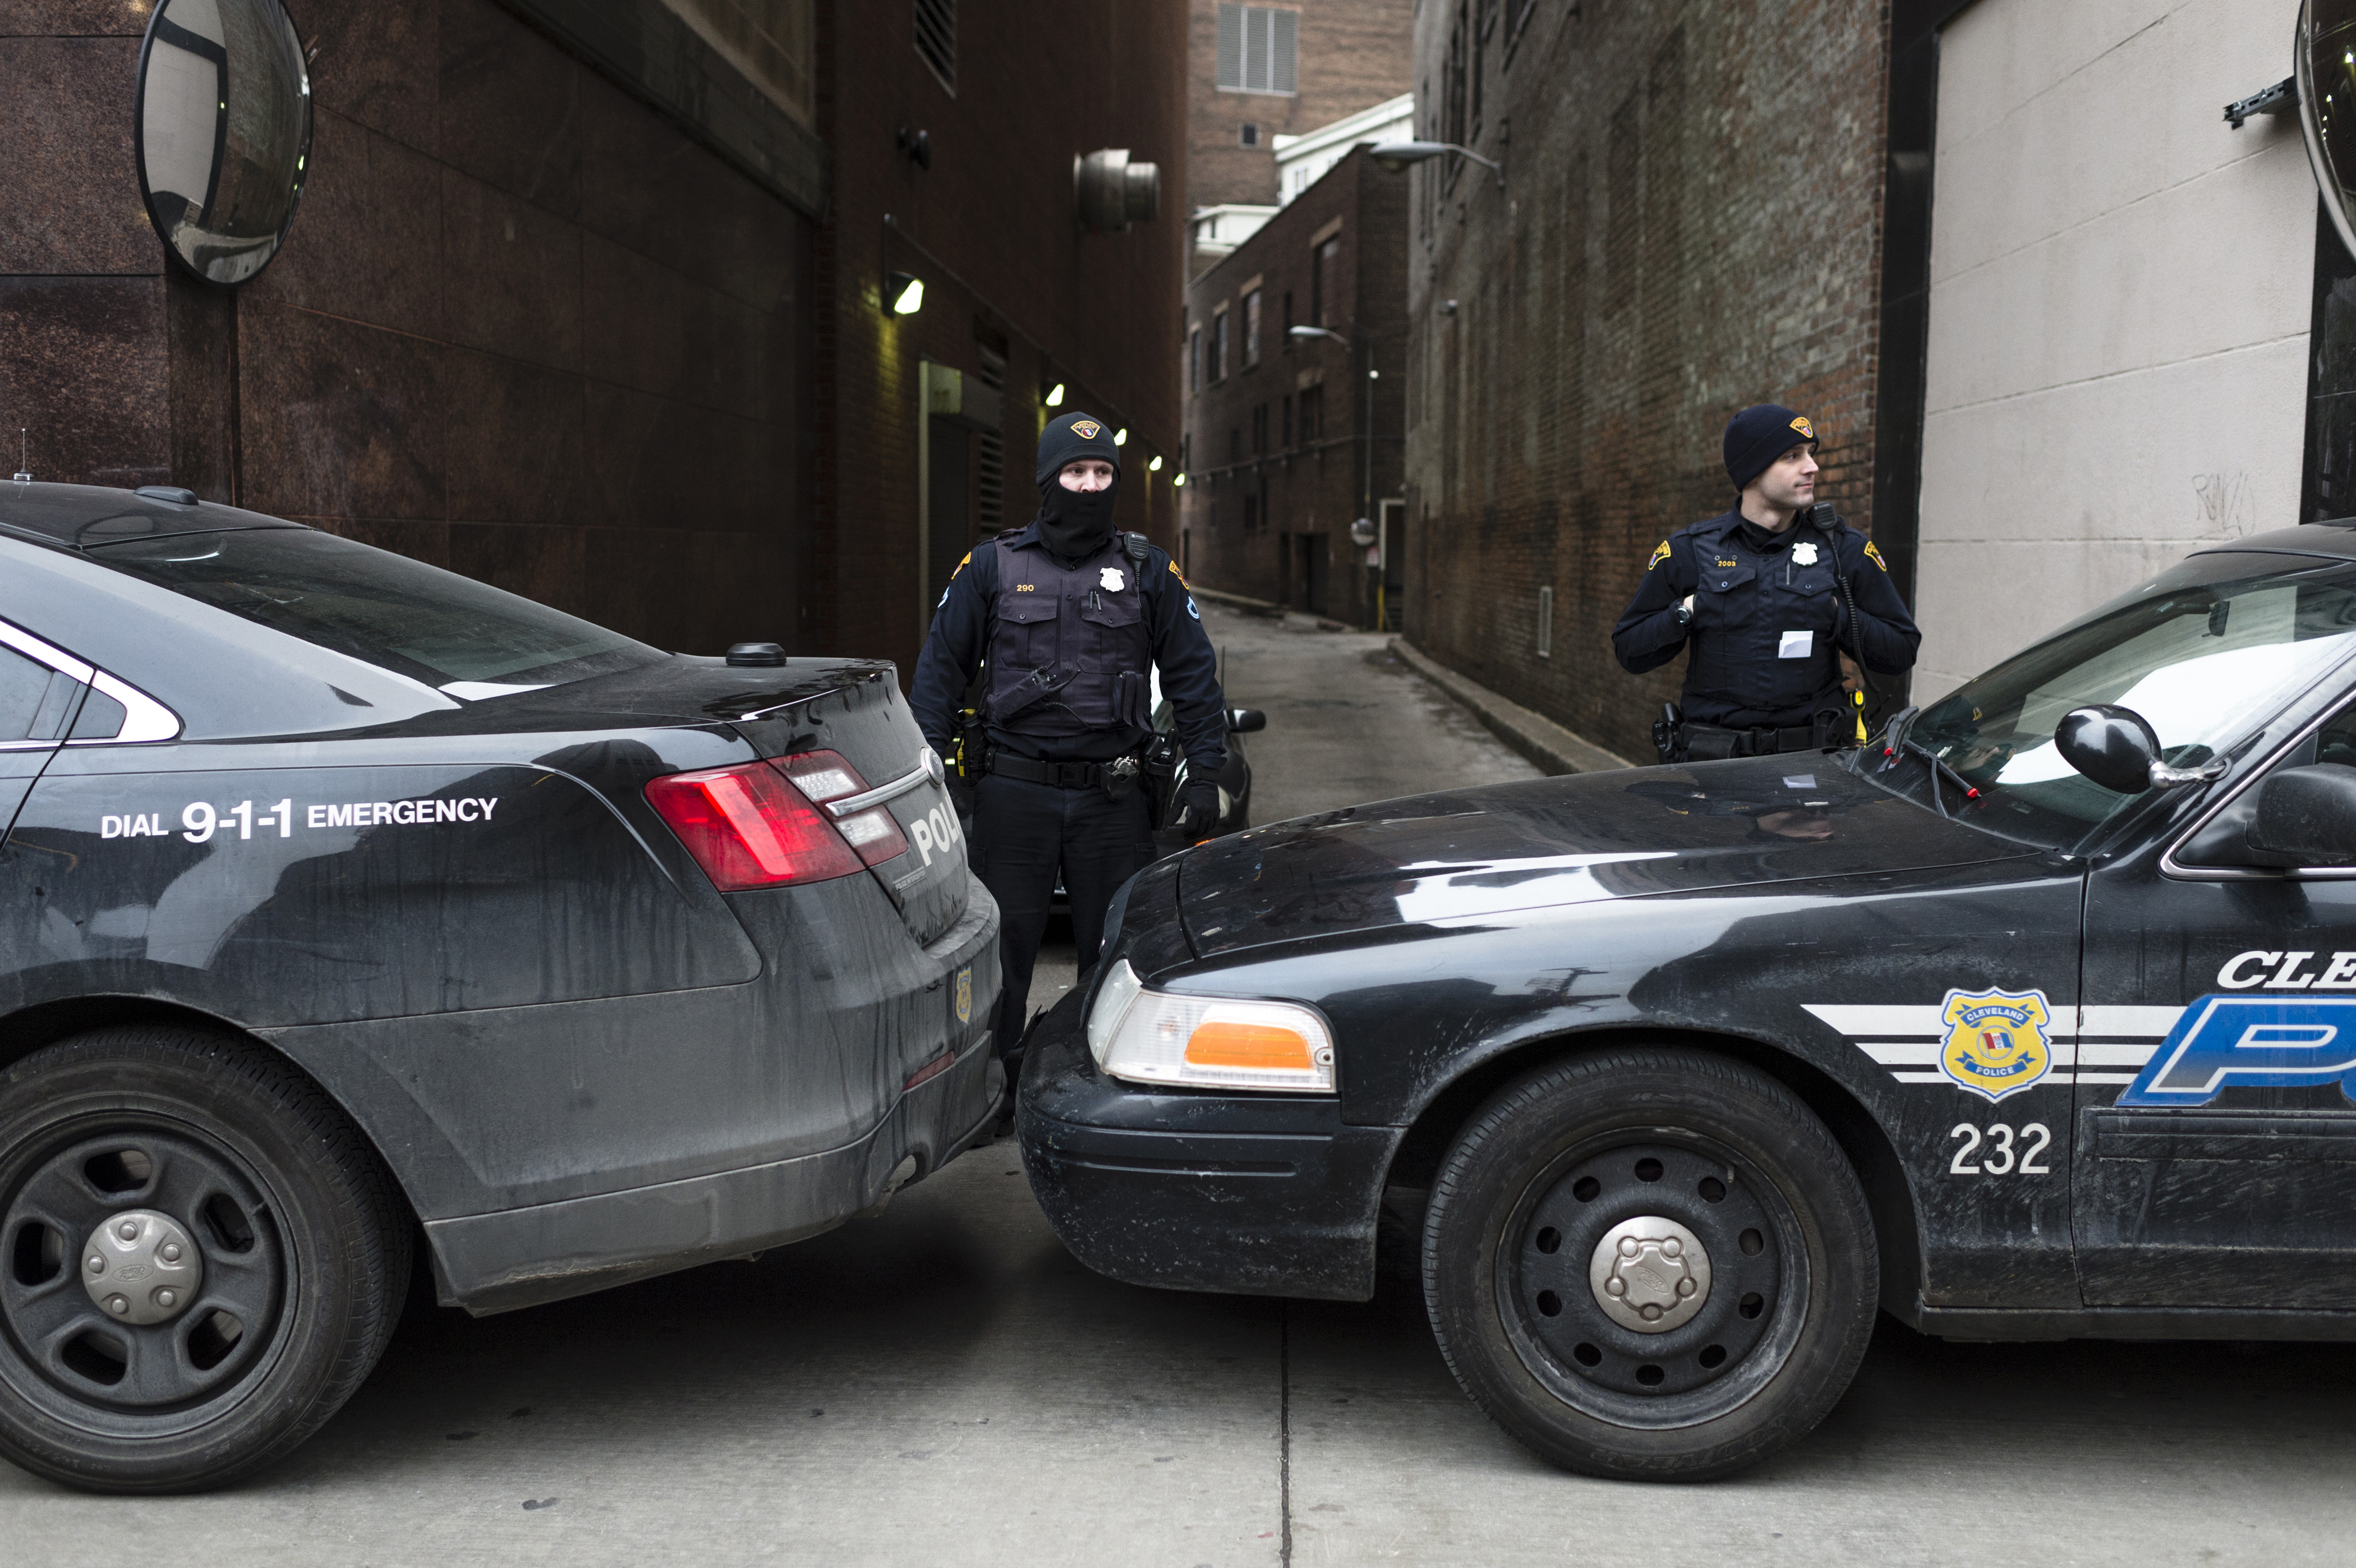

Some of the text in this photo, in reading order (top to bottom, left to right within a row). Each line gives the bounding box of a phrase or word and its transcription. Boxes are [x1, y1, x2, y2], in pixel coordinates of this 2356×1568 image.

[102, 798, 498, 843] DIAL 9-1-1 EMERGENCY
[910, 796, 961, 867] POLI
[2217, 950, 2356, 989] CLE
[1967, 1007, 2024, 1021] CLEVELAND
[1976, 1066, 2015, 1076] POLICE
[1950, 1123, 2051, 1175] 232
